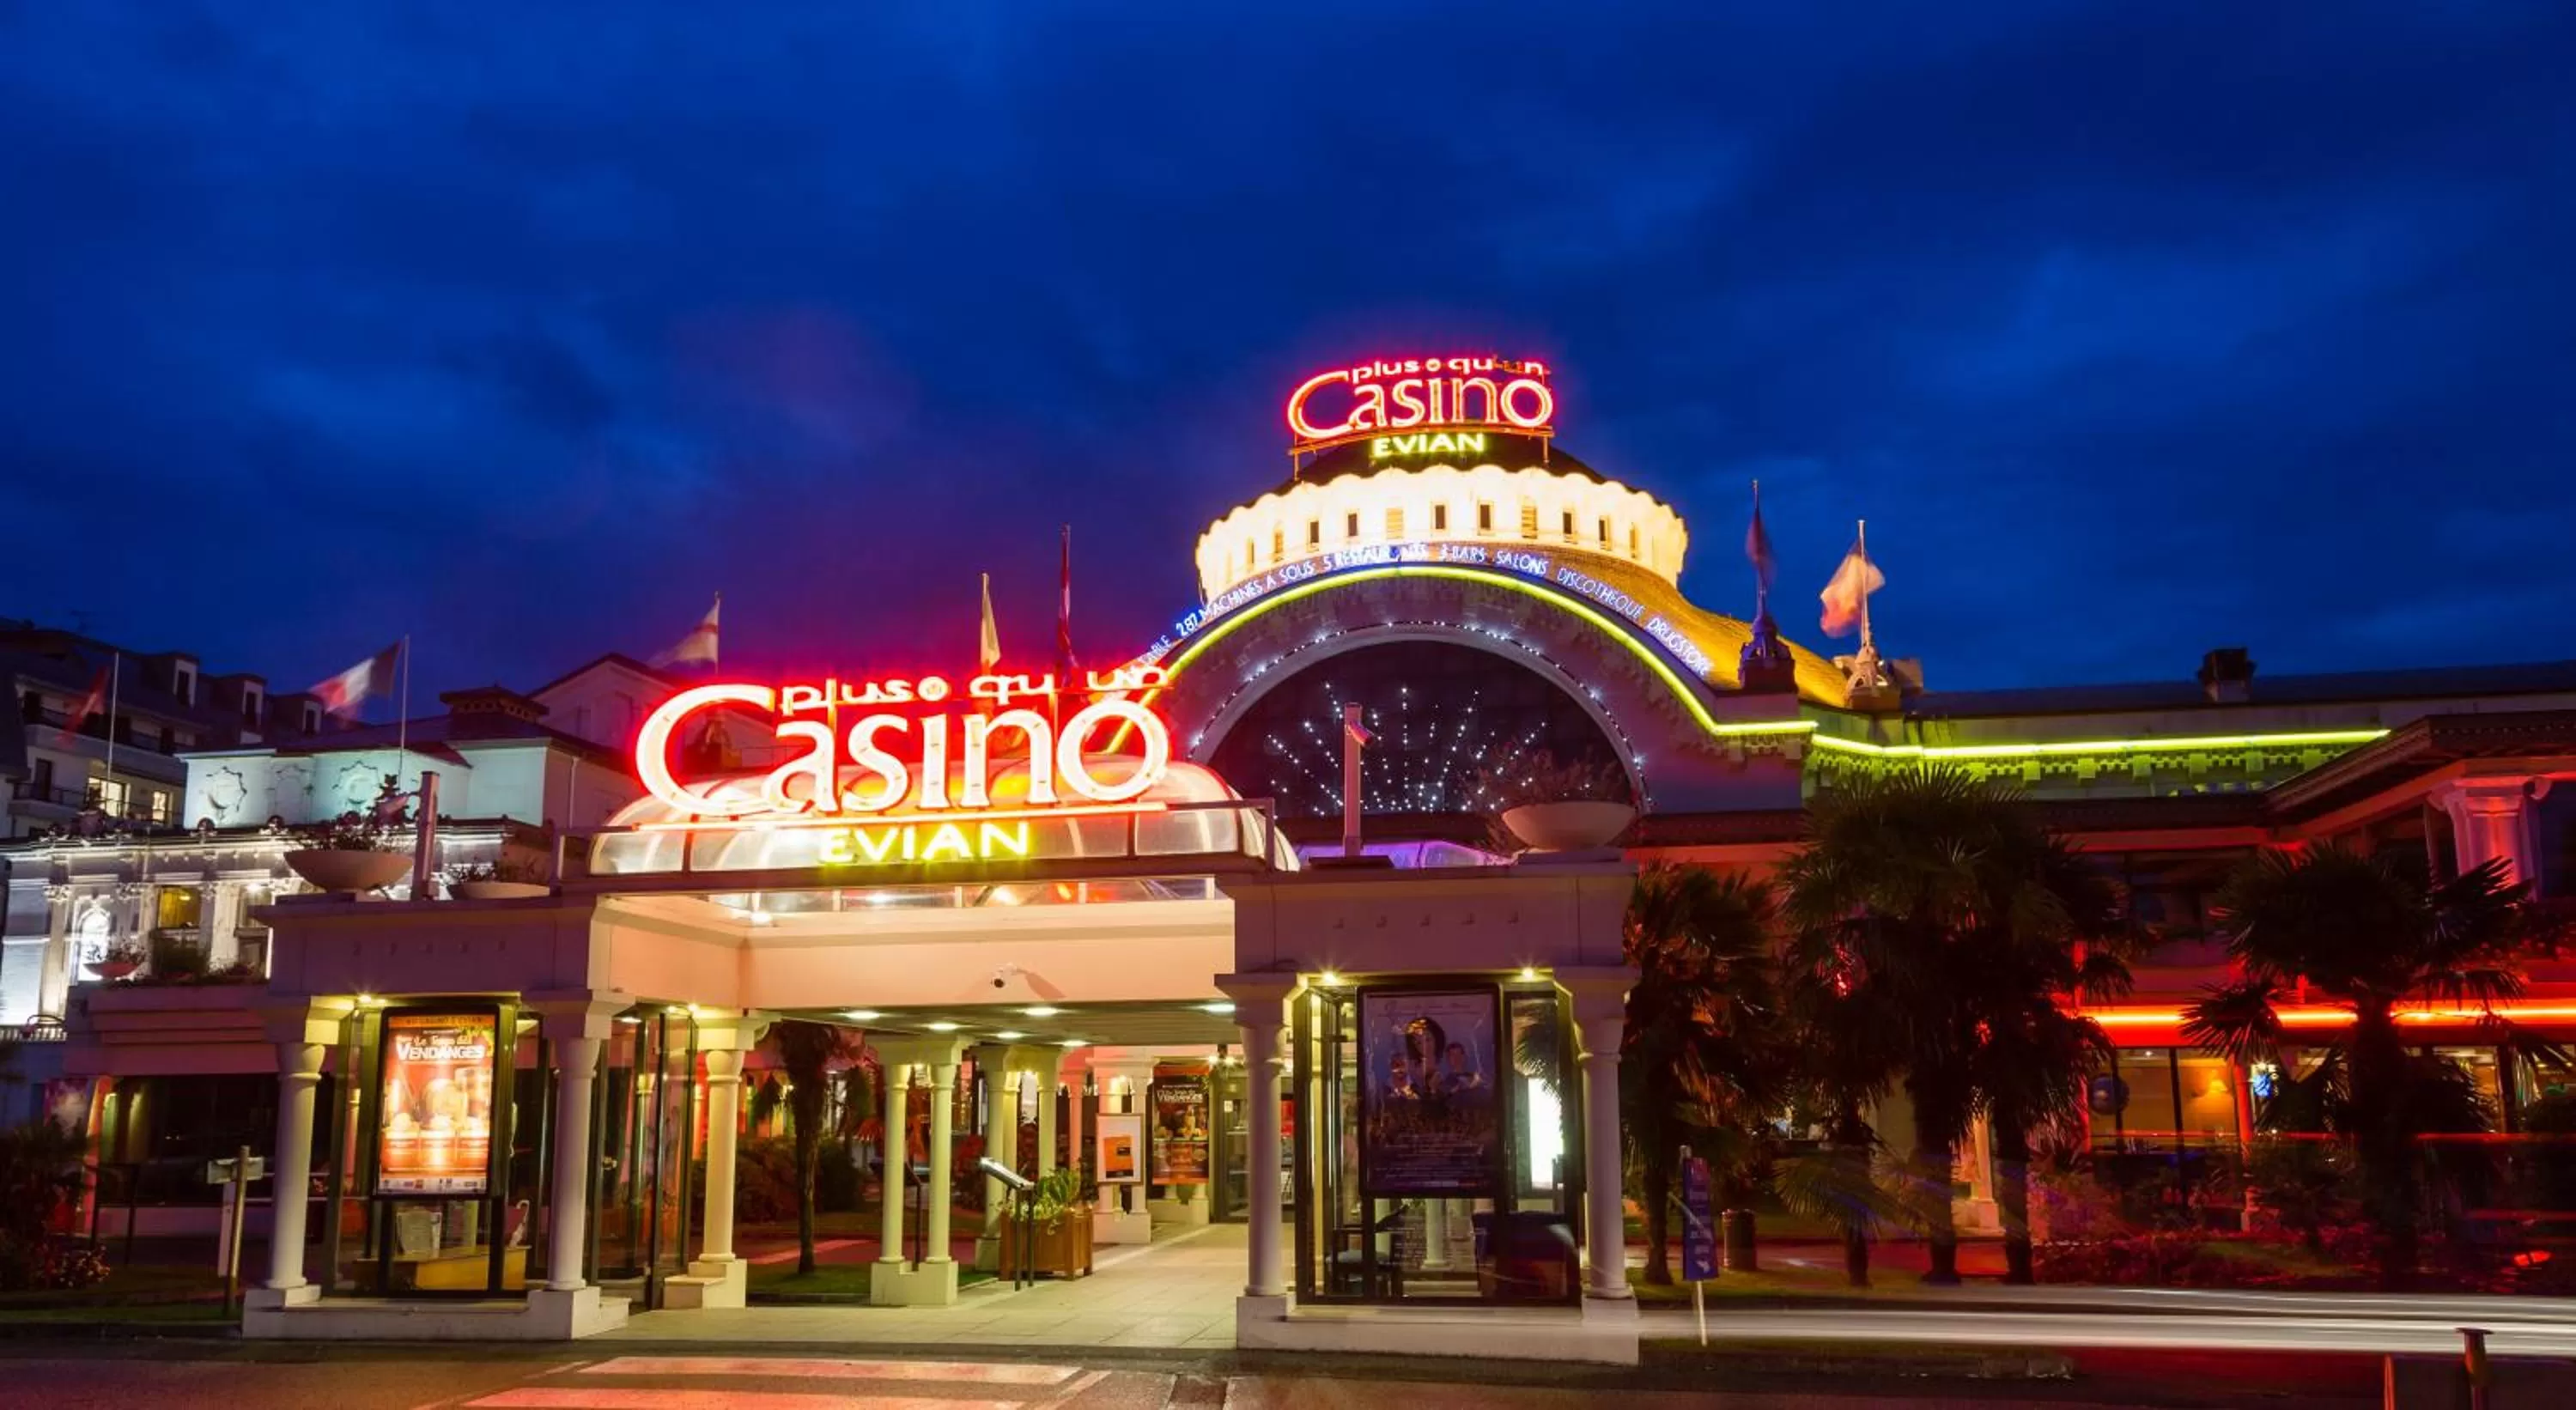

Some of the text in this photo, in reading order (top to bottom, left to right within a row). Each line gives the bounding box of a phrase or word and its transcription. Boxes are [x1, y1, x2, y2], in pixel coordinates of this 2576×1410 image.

[1352, 360, 1419, 384] plus
[1288, 370, 1553, 438] Casino
[1374, 433, 1485, 457] EVIAN
[1176, 612, 1199, 638] 287
[1199, 580, 1264, 621] MACHINES
[1279, 561, 1316, 584] SOUS
[1322, 555, 1333, 571] 5
[1495, 550, 1549, 576] SALONS
[783, 678, 912, 716] plus
[635, 683, 1170, 815] Casino
[821, 823, 1029, 864] EVIAN
[396, 1043, 486, 1061] VENDANGES
